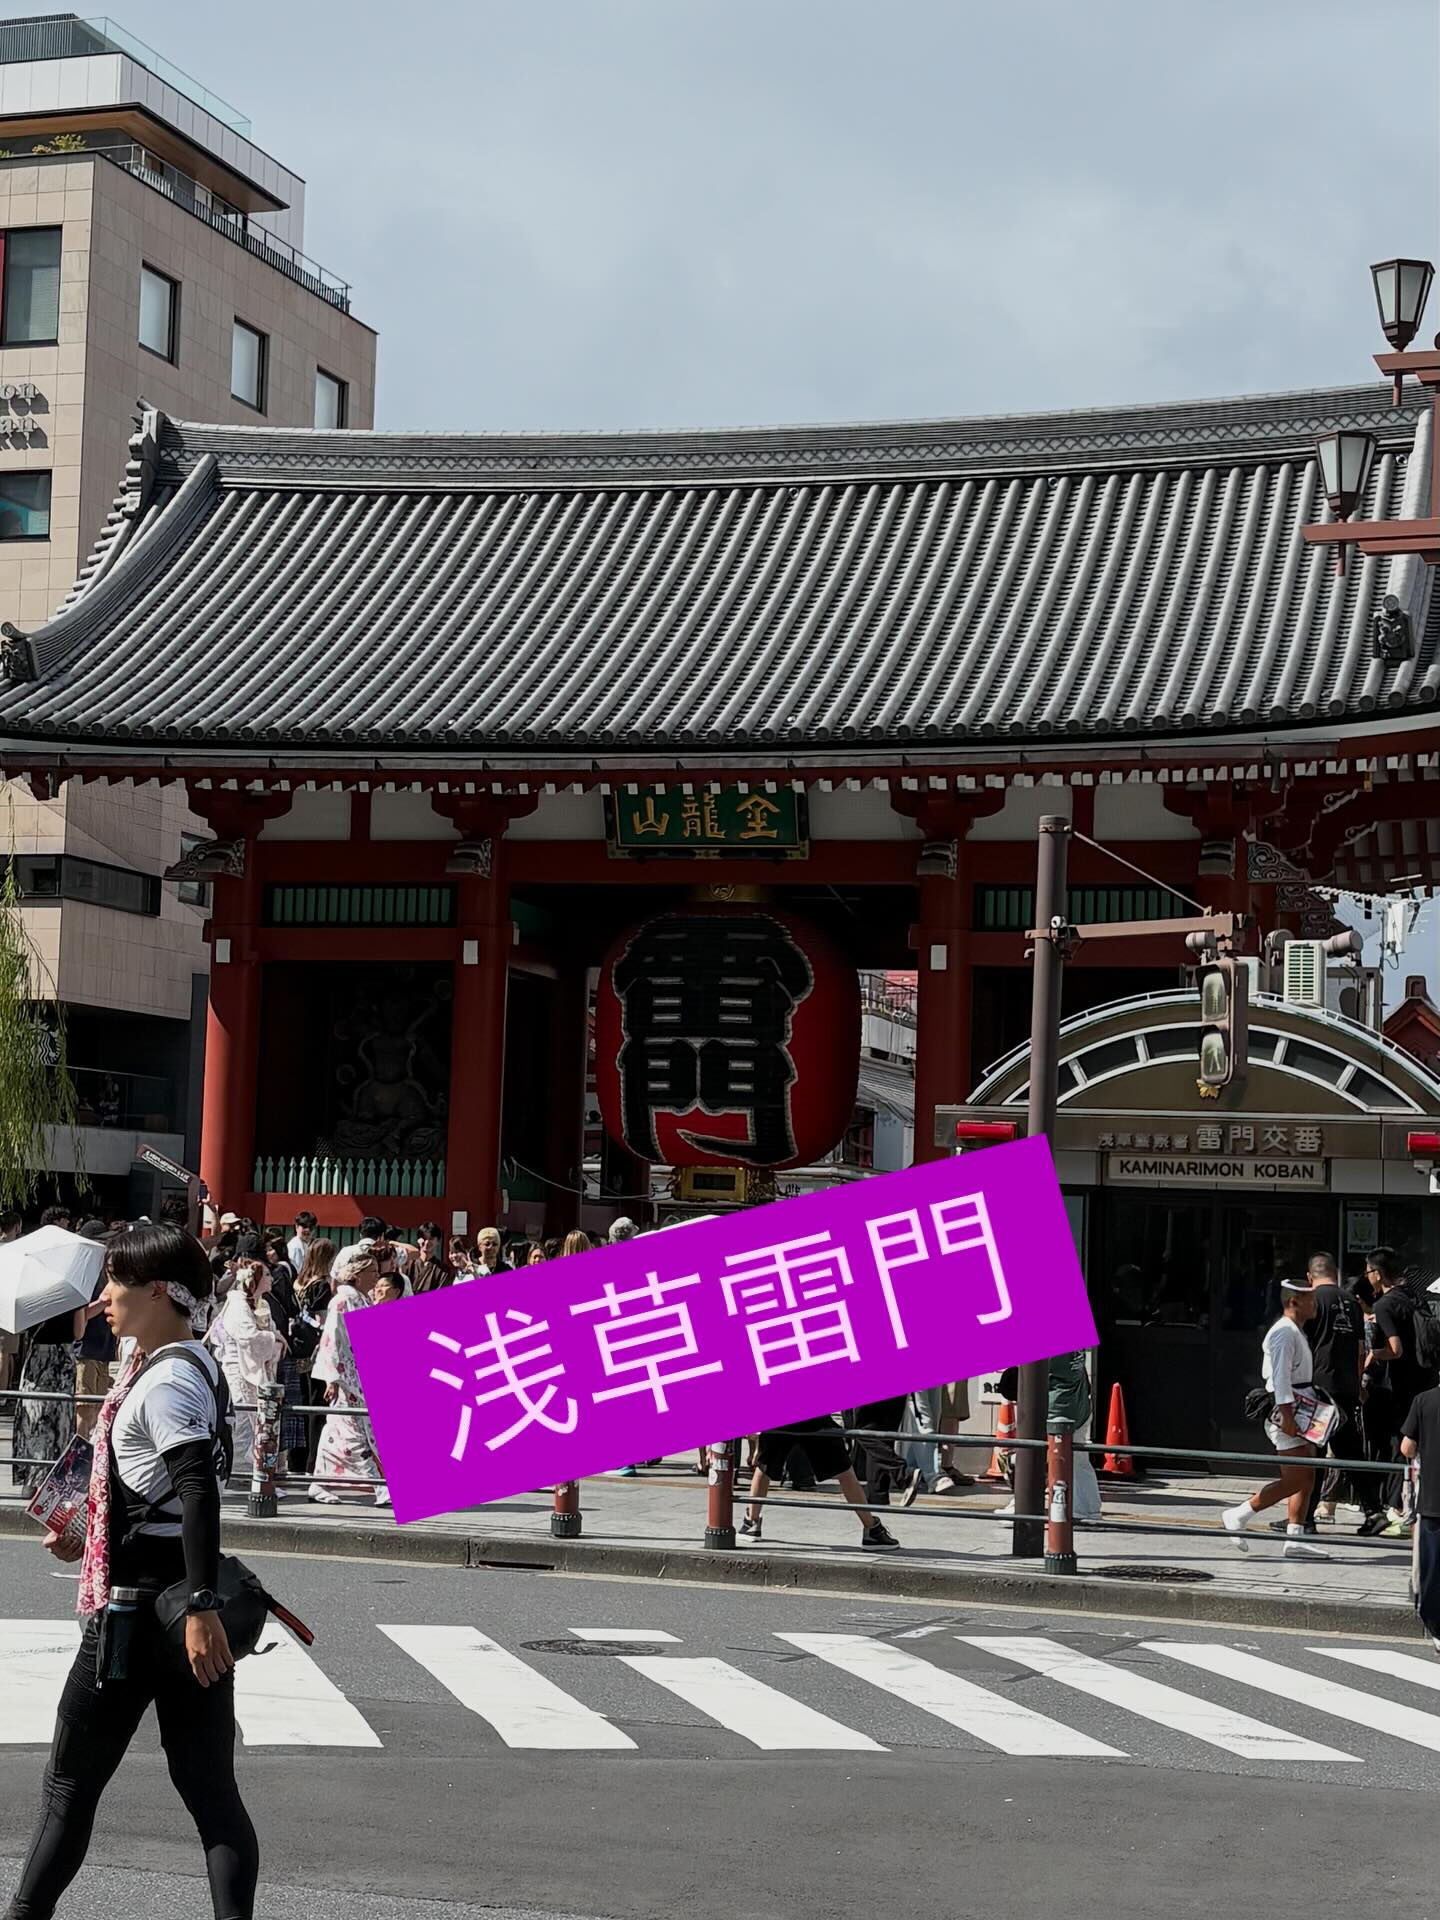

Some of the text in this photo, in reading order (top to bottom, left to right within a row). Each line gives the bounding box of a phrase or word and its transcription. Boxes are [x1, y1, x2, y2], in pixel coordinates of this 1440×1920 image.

[612, 913, 815, 1166] 雷門
[1196, 1124, 1322, 1152] 雷門交番
[1120, 1160, 1315, 1179] KAMINARIMON KOBAN
